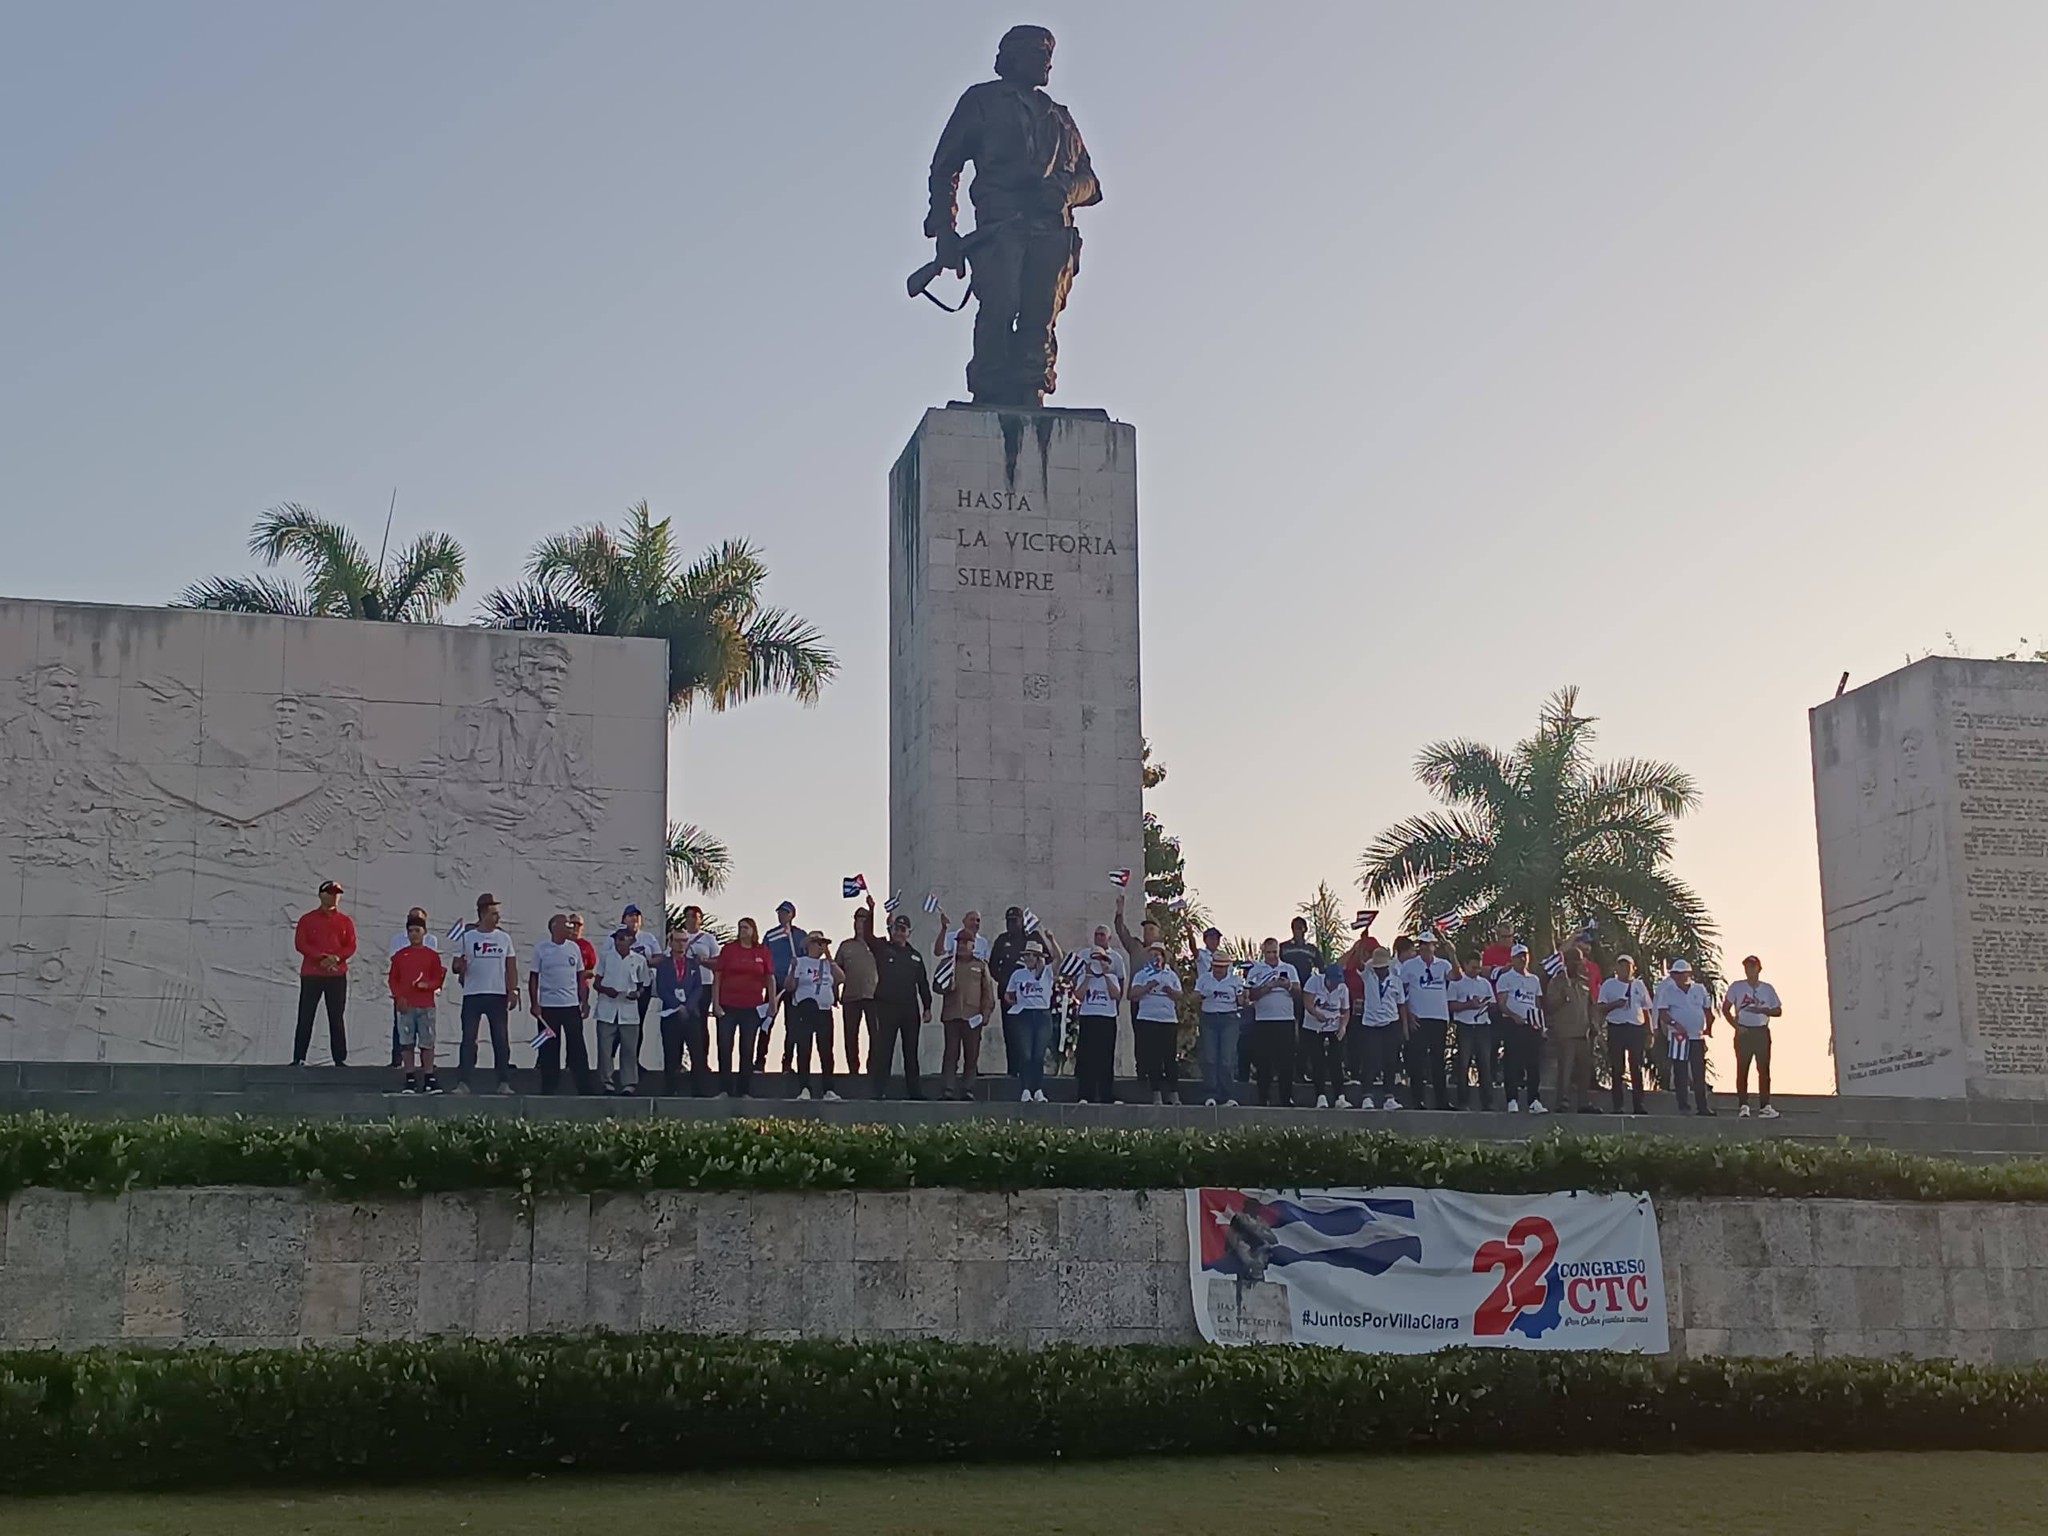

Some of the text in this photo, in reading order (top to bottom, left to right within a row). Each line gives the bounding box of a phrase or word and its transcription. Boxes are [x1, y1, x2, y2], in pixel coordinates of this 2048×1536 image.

[957, 489, 1032, 511] HASTA
[957, 528, 1118, 556] LA VICTORIA
[957, 568, 1055, 591] SIEMPRE
[1472, 1216, 1559, 1336] 22
[1560, 1259, 1646, 1278] CONGRESO
[1567, 1274, 1649, 1315] CTC
[1302, 1309, 1459, 1330] #JuntosPorVillaClara
